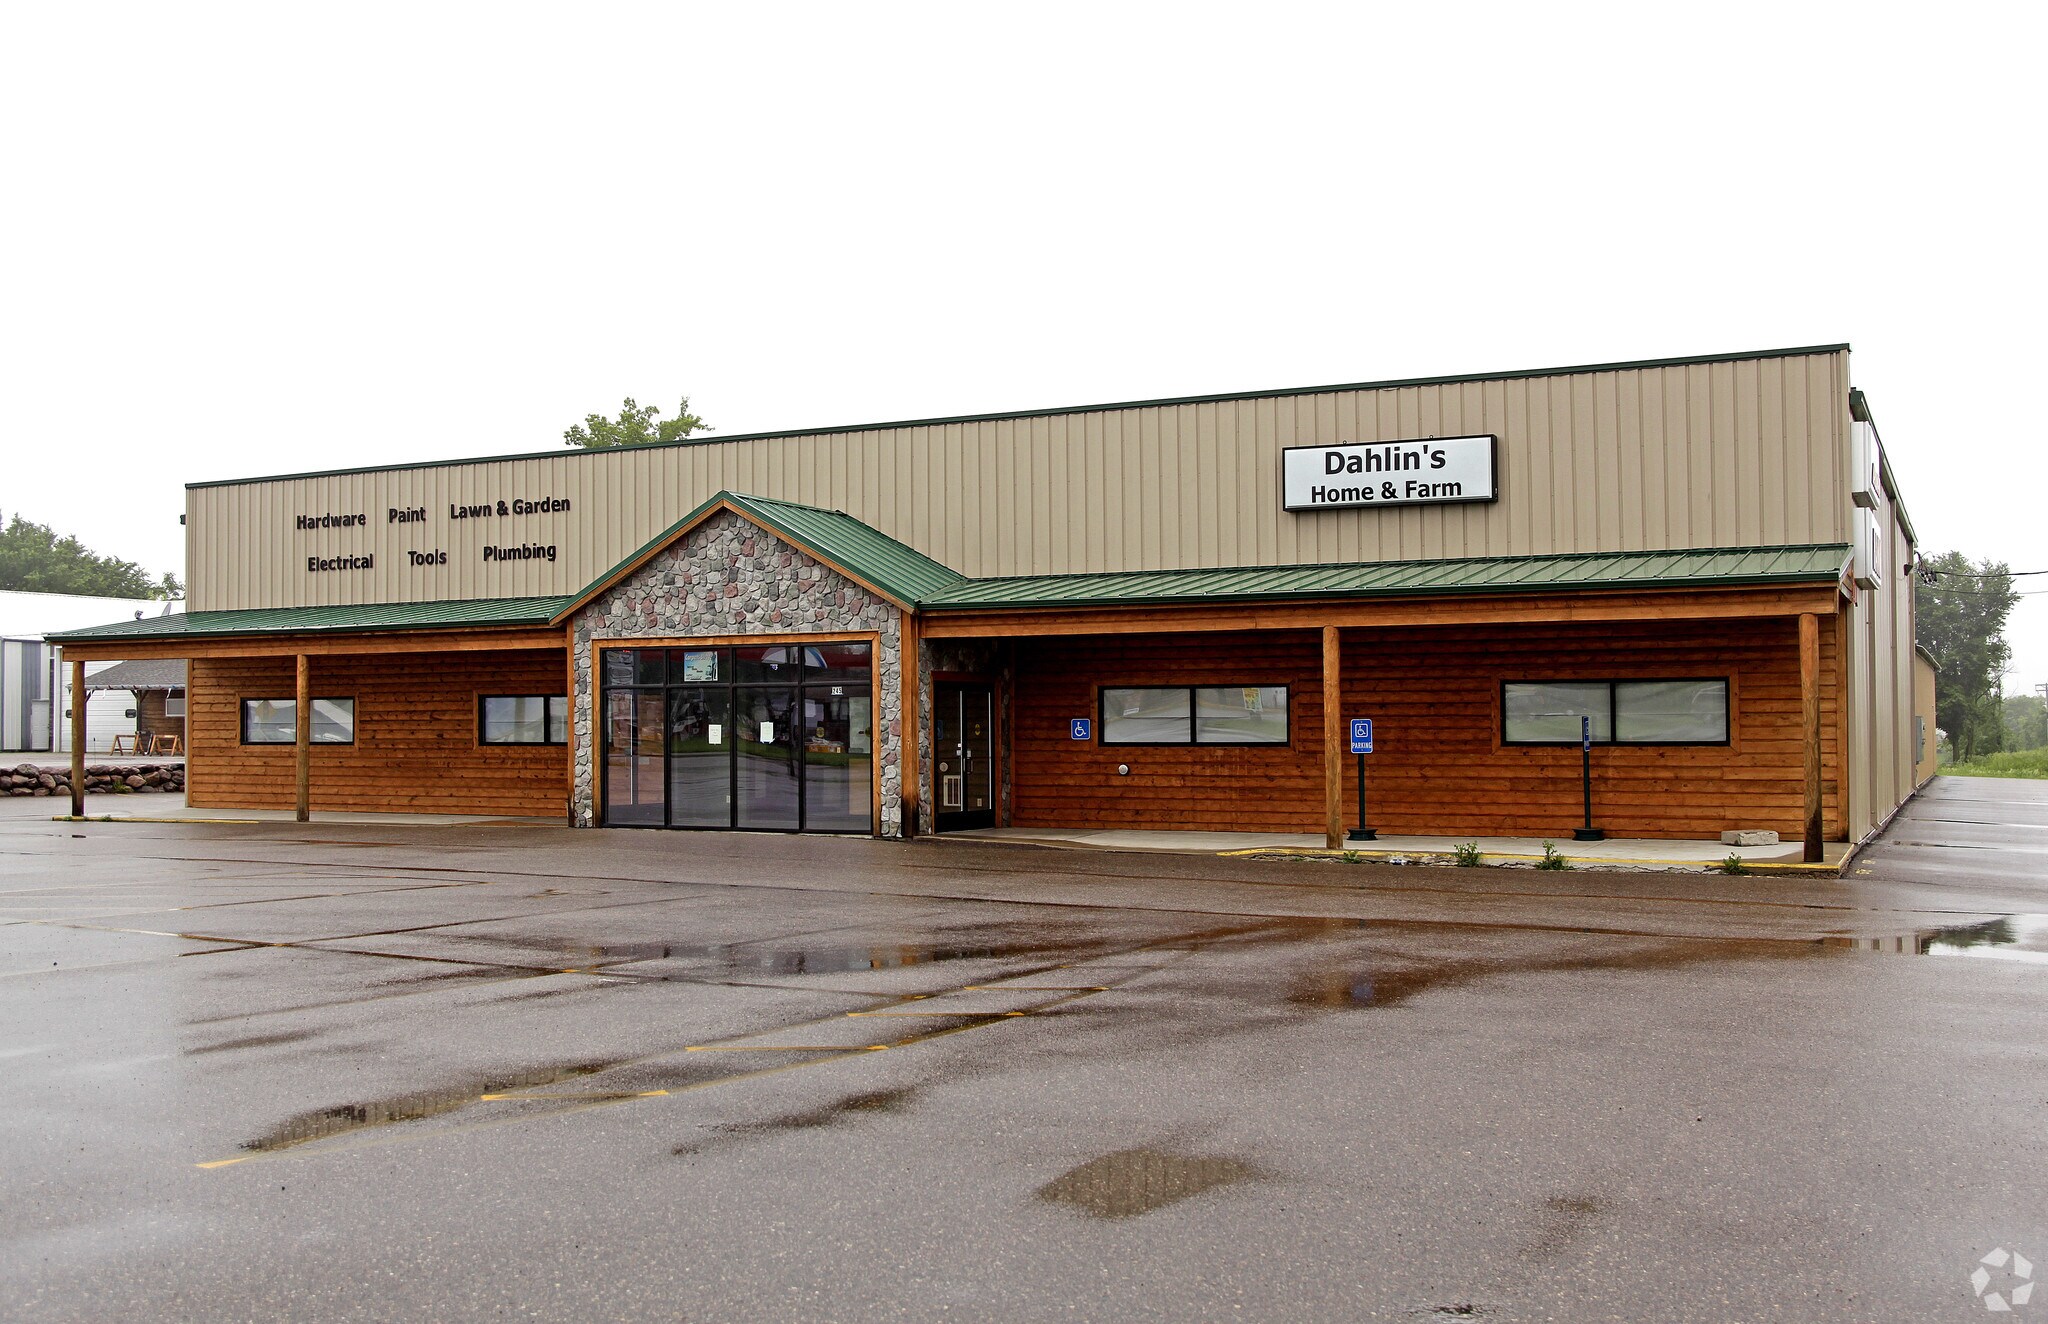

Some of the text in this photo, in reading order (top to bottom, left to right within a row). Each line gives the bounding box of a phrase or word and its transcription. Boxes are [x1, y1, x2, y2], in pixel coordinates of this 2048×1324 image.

[1325, 444, 1446, 475] Dahlin's
[1311, 480, 1462, 503] Home & Farm
[388, 506, 426, 523] Paint
[450, 496, 571, 520] Lawn & Garden
[296, 512, 366, 530] Hardware
[407, 548, 447, 567] Tools
[483, 542, 557, 562] Plumbing
[307, 553, 374, 572] Electrical
